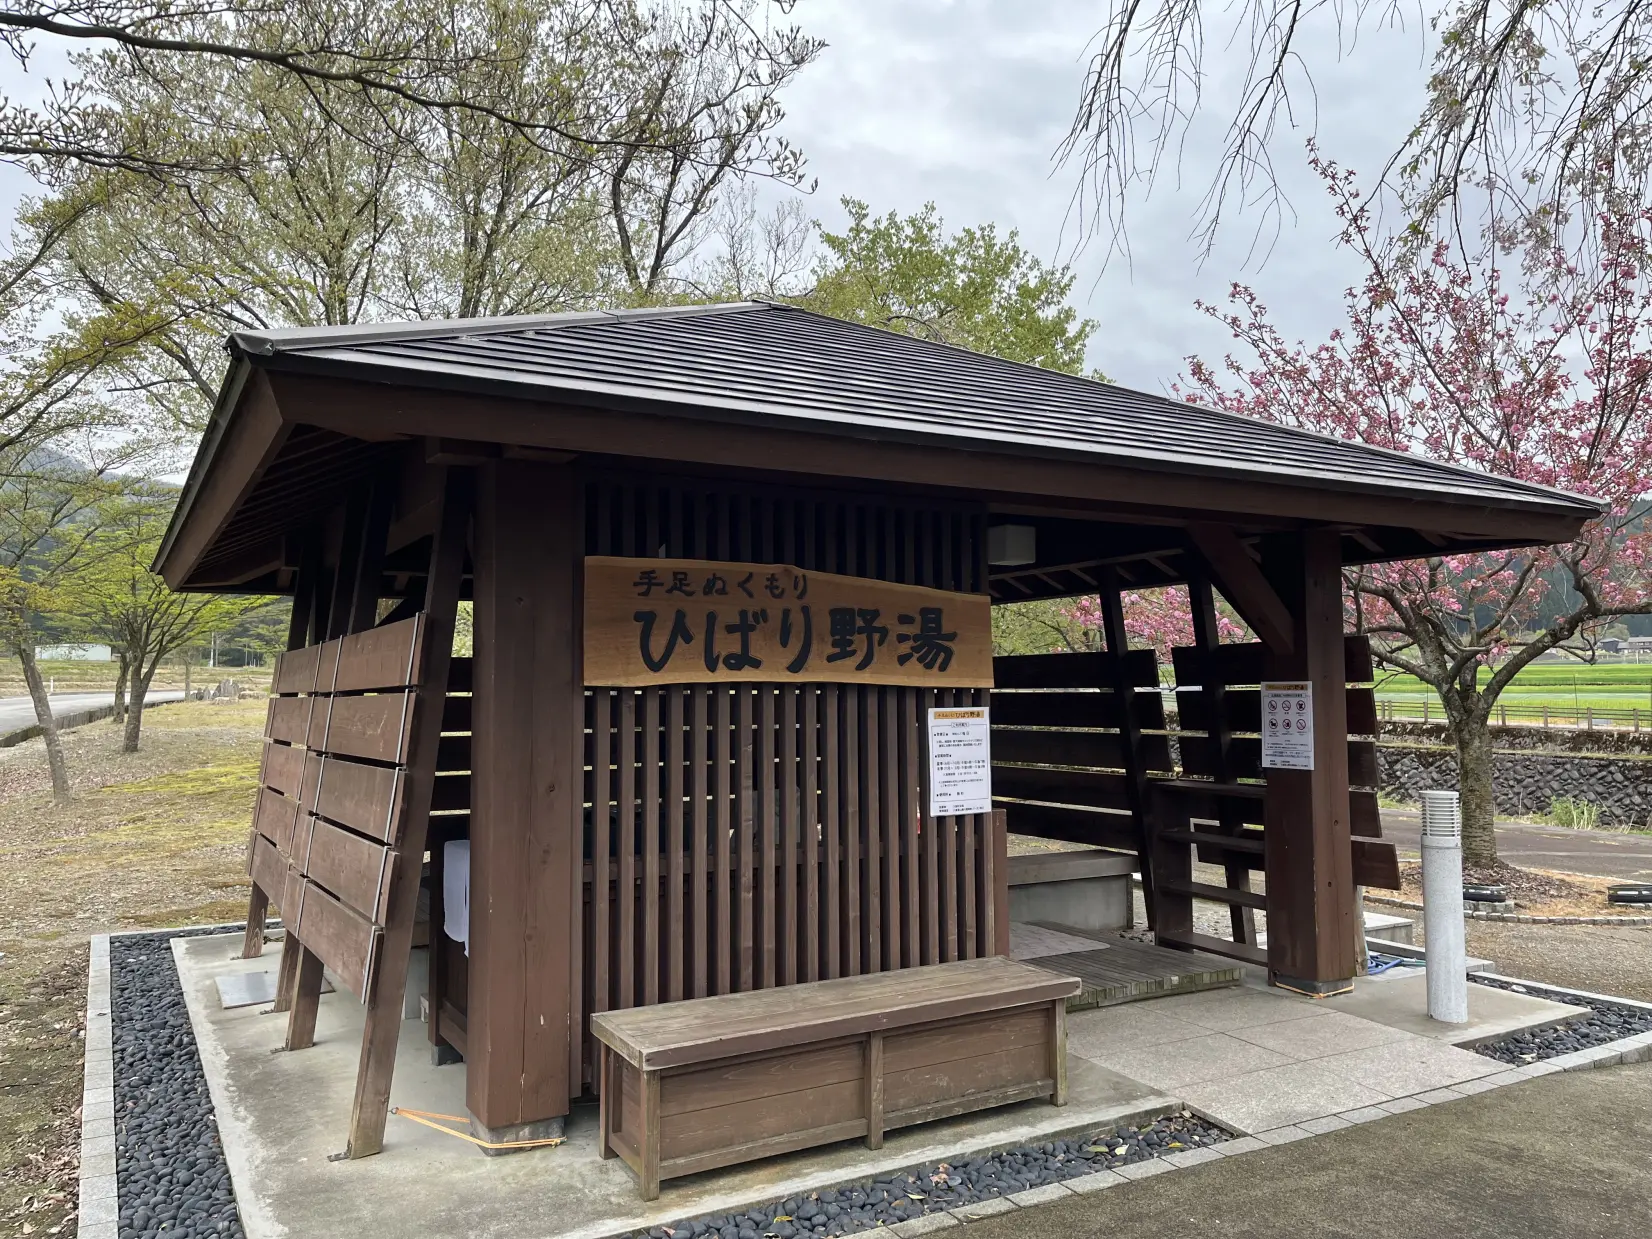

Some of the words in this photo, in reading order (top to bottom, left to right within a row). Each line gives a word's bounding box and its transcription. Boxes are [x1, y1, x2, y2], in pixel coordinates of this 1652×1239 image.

[632, 569, 809, 600] 手足ぬくもり
[633, 605, 958, 673] ひばり野湯
